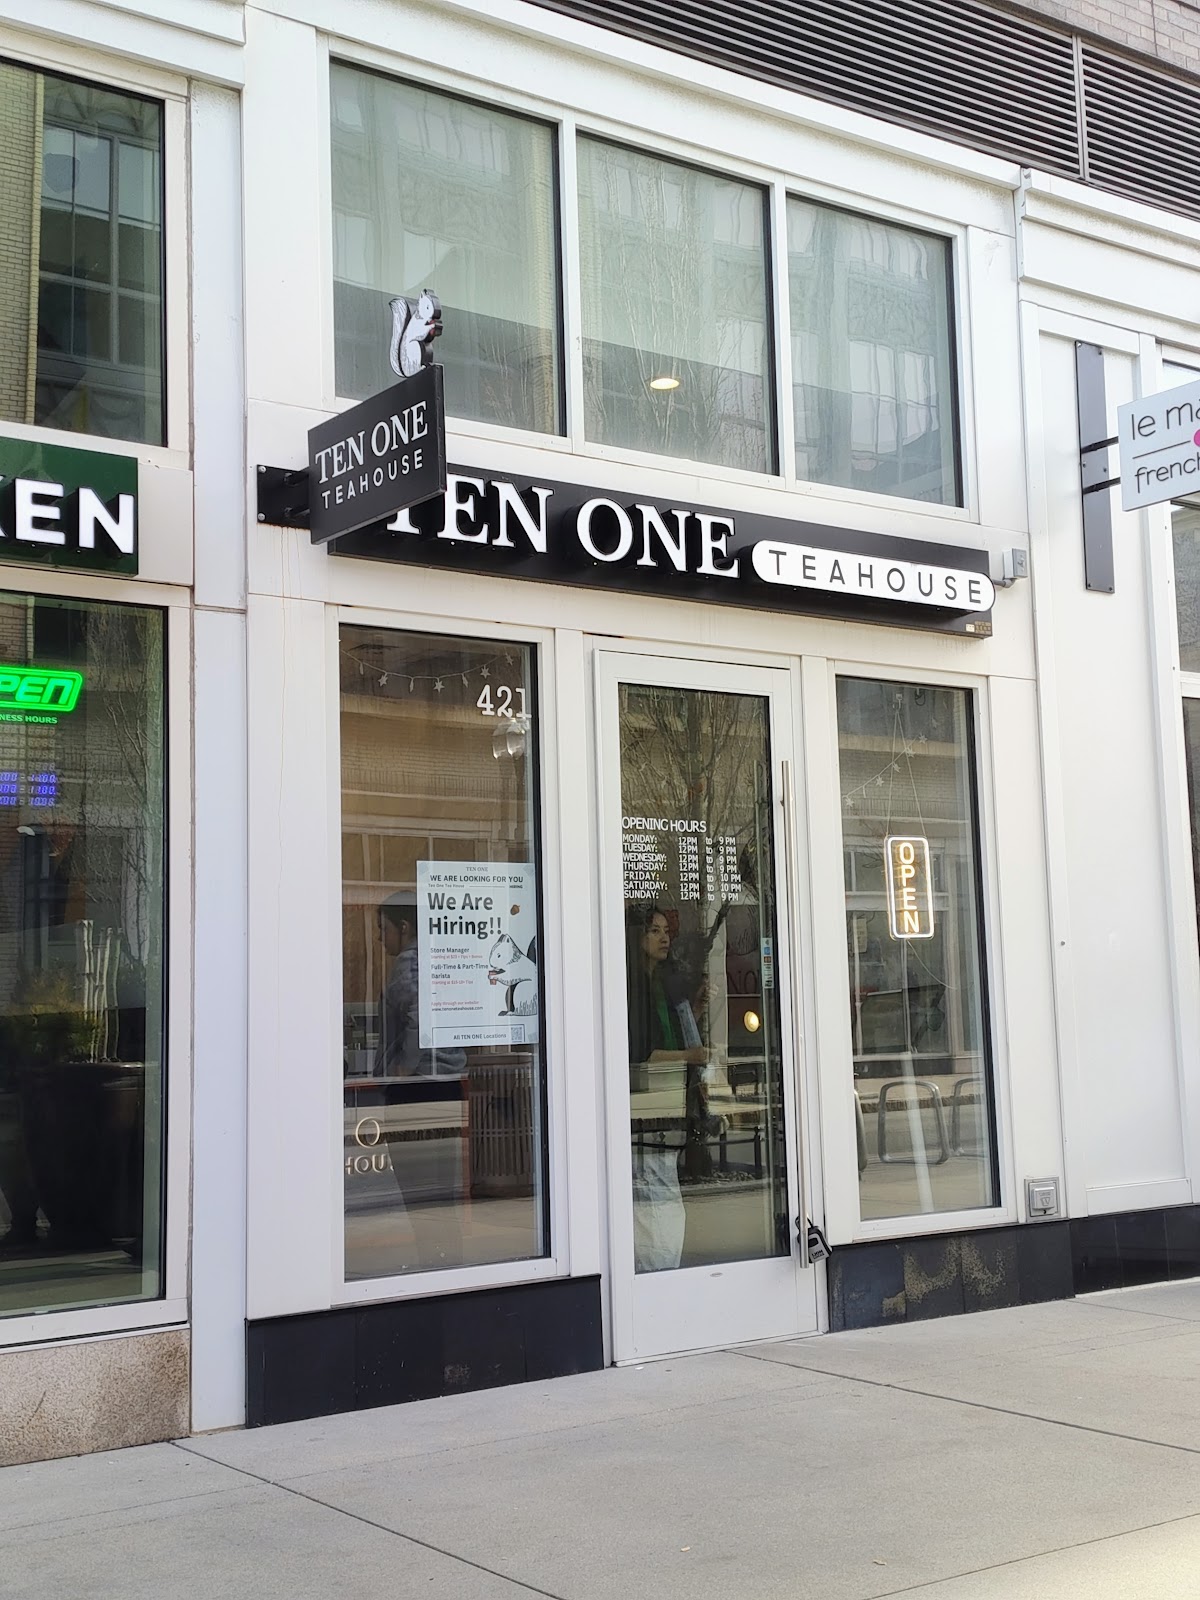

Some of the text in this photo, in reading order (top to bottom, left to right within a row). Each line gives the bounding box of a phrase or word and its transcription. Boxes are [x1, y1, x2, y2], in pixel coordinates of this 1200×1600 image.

[1132, 414, 1156, 440] le
[315, 401, 428, 484] TEN ONE
[322, 448, 422, 509] TEAHOUSE
[0, 475, 134, 554] EN
[576, 498, 742, 578] ONE
[768, 549, 982, 604] TEAHOUSE
[477, 684, 532, 718] 421
[25, 716, 58, 724] HOURS
[622, 817, 706, 832] OPENING HOURS
[623, 834, 658, 844] MONDAY:
[719, 836, 724, 845] 9
[726, 837, 735, 845] PM
[623, 843, 658, 852] TUESDAY:
[720, 846, 724, 854] 9
[623, 853, 666, 862] WEDNESDAY:
[720, 856, 724, 864] 9
[727, 856, 736, 864] PM
[623, 862, 667, 872] THURSDAY:
[706, 865, 714, 873] to
[720, 865, 724, 874] 9
[727, 865, 736, 873] PM
[624, 872, 660, 880] FRIDAY:
[707, 874, 714, 882] to
[720, 874, 728, 882] 10
[731, 874, 741, 882] PM
[624, 881, 668, 890] SATURDAY:
[720, 884, 728, 892] 10
[731, 884, 741, 892] PM
[624, 890, 659, 899] SUNDAY:
[708, 893, 714, 901] to
[722, 892, 726, 901] 9
[728, 893, 738, 901] PM
[900, 842, 920, 933] OPEN
[428, 892, 494, 910] We Are
[429, 916, 502, 940] Hiring!!
